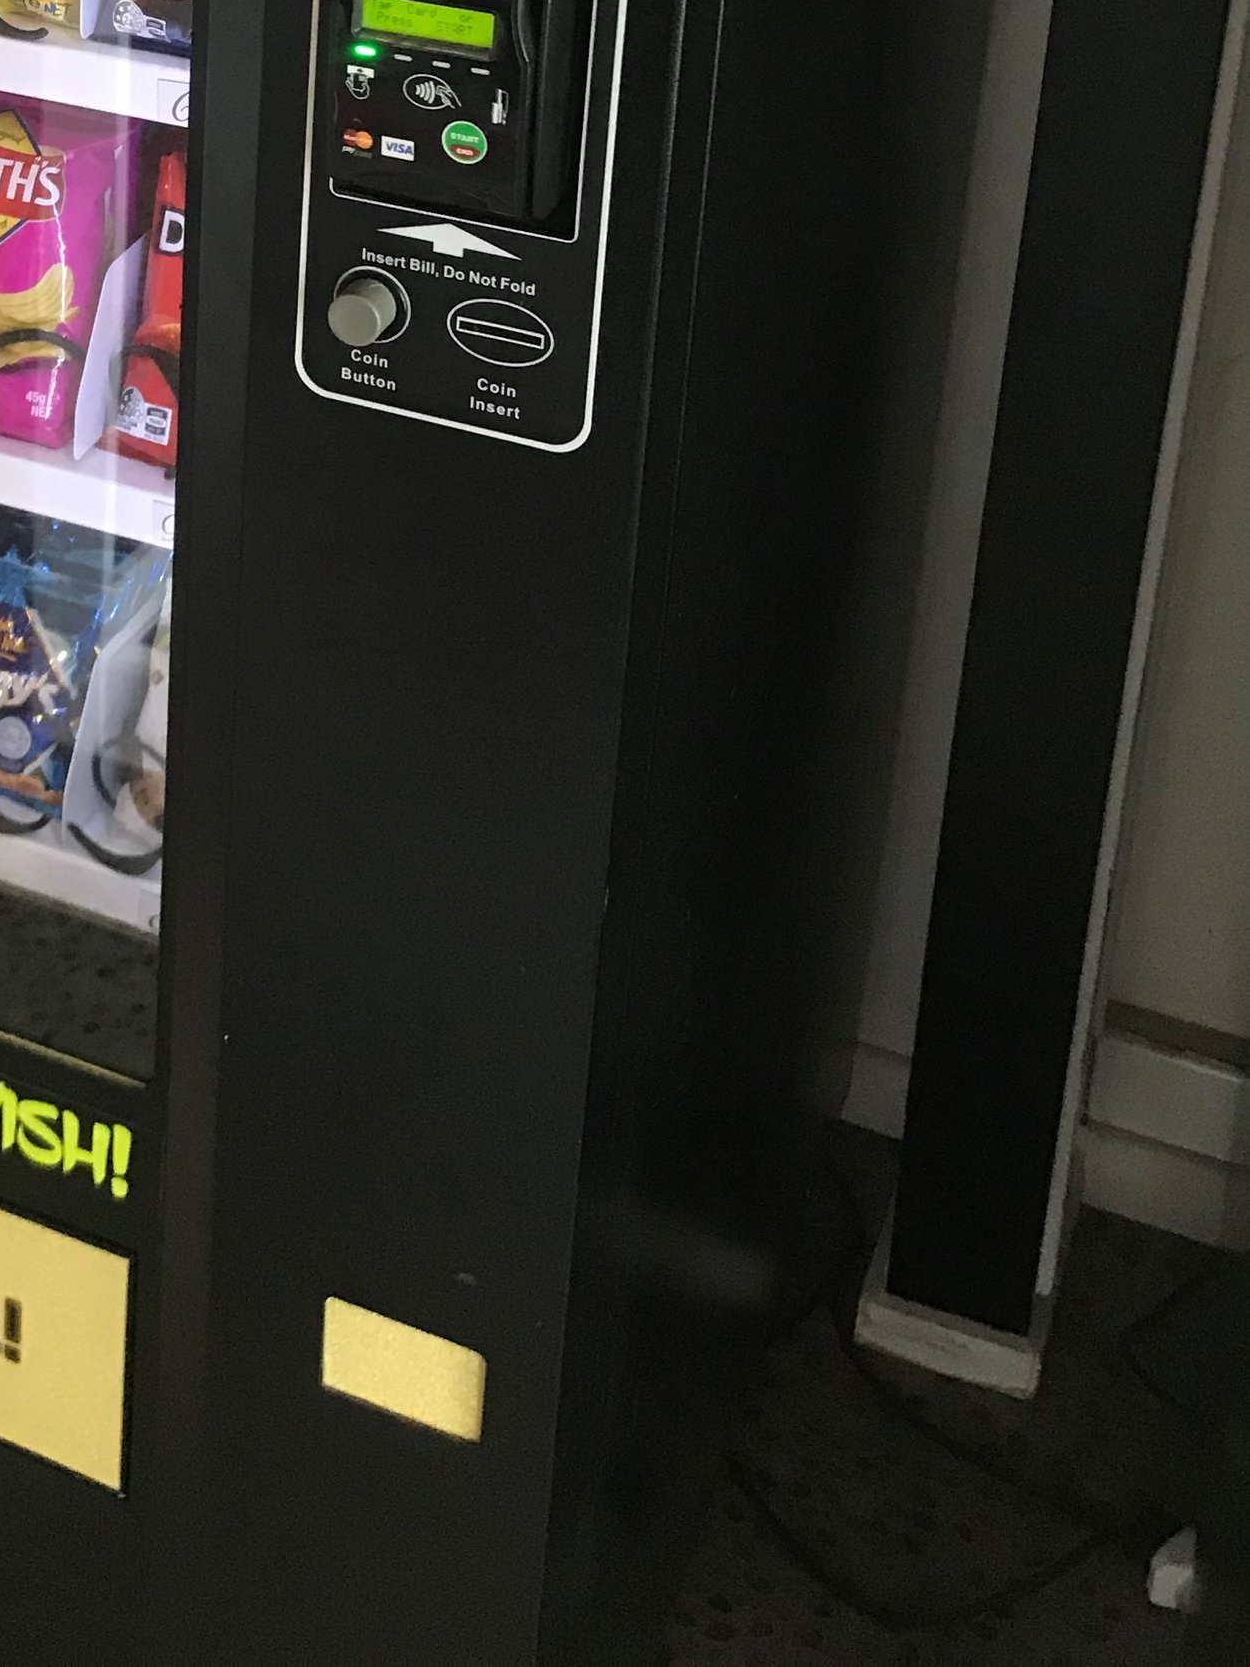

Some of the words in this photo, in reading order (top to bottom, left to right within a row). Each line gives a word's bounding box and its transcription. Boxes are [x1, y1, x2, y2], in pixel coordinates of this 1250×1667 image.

[385, 141, 414, 156] VISA
[450, 132, 479, 144] START
[361, 247, 406, 269] Insert
[410, 257, 440, 278] Bill,
[444, 265, 465, 281] Do
[469, 270, 497, 289] Not
[500, 276, 536, 296] Fold
[350, 348, 389, 369] Coin
[341, 367, 397, 391] Button
[476, 377, 517, 398] Coin
[469, 395, 521, 420] Insert
